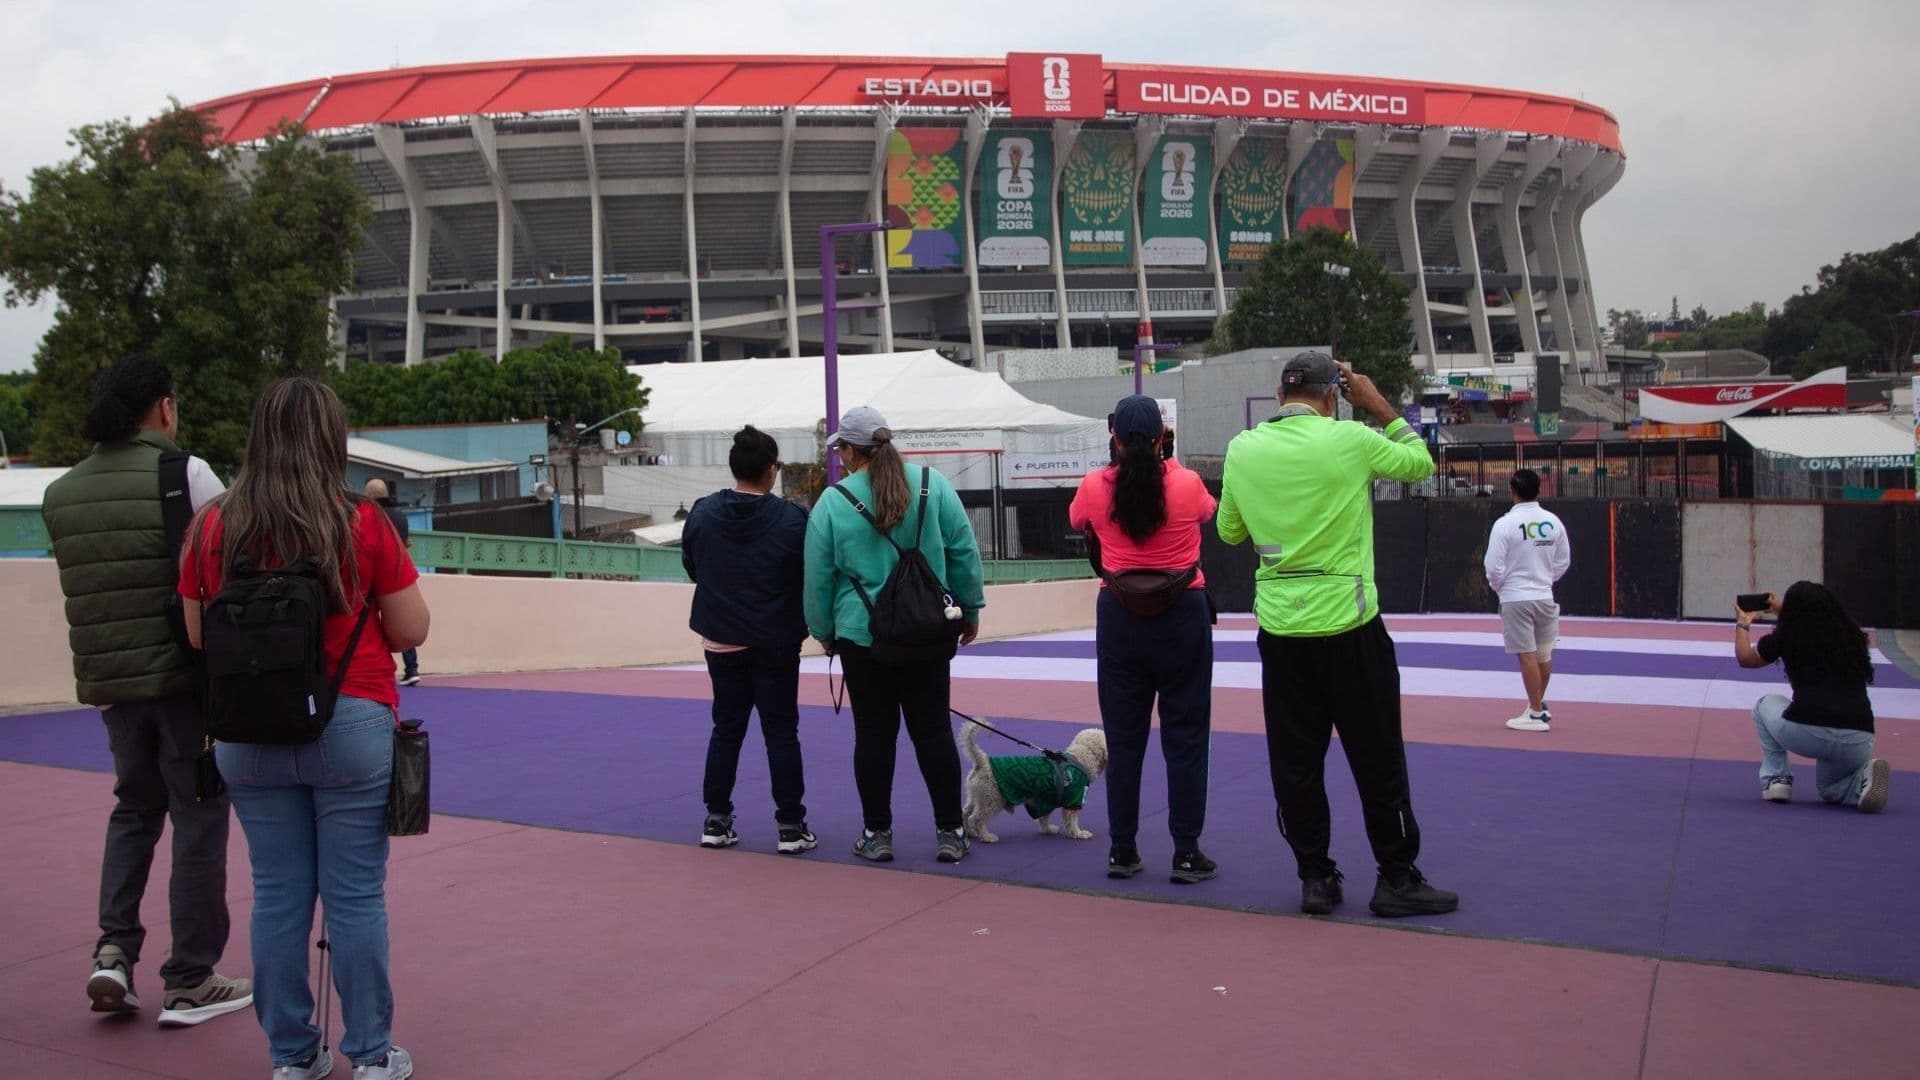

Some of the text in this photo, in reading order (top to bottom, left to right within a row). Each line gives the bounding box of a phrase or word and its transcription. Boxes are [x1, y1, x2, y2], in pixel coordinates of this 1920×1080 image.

[864, 77, 993, 97] ESTADIO
[1140, 82, 1408, 115] CIUDAD DE MÉXICO
[997, 201, 1033, 212] COPA
[1160, 209, 1193, 218] 2026
[997, 221, 1034, 230] 2026
[1069, 229, 1125, 242] WE ARE
[1026, 461, 1079, 470] PUERTA 11
[1799, 457, 1842, 471] COPA
[1519, 521, 1554, 540] 100
